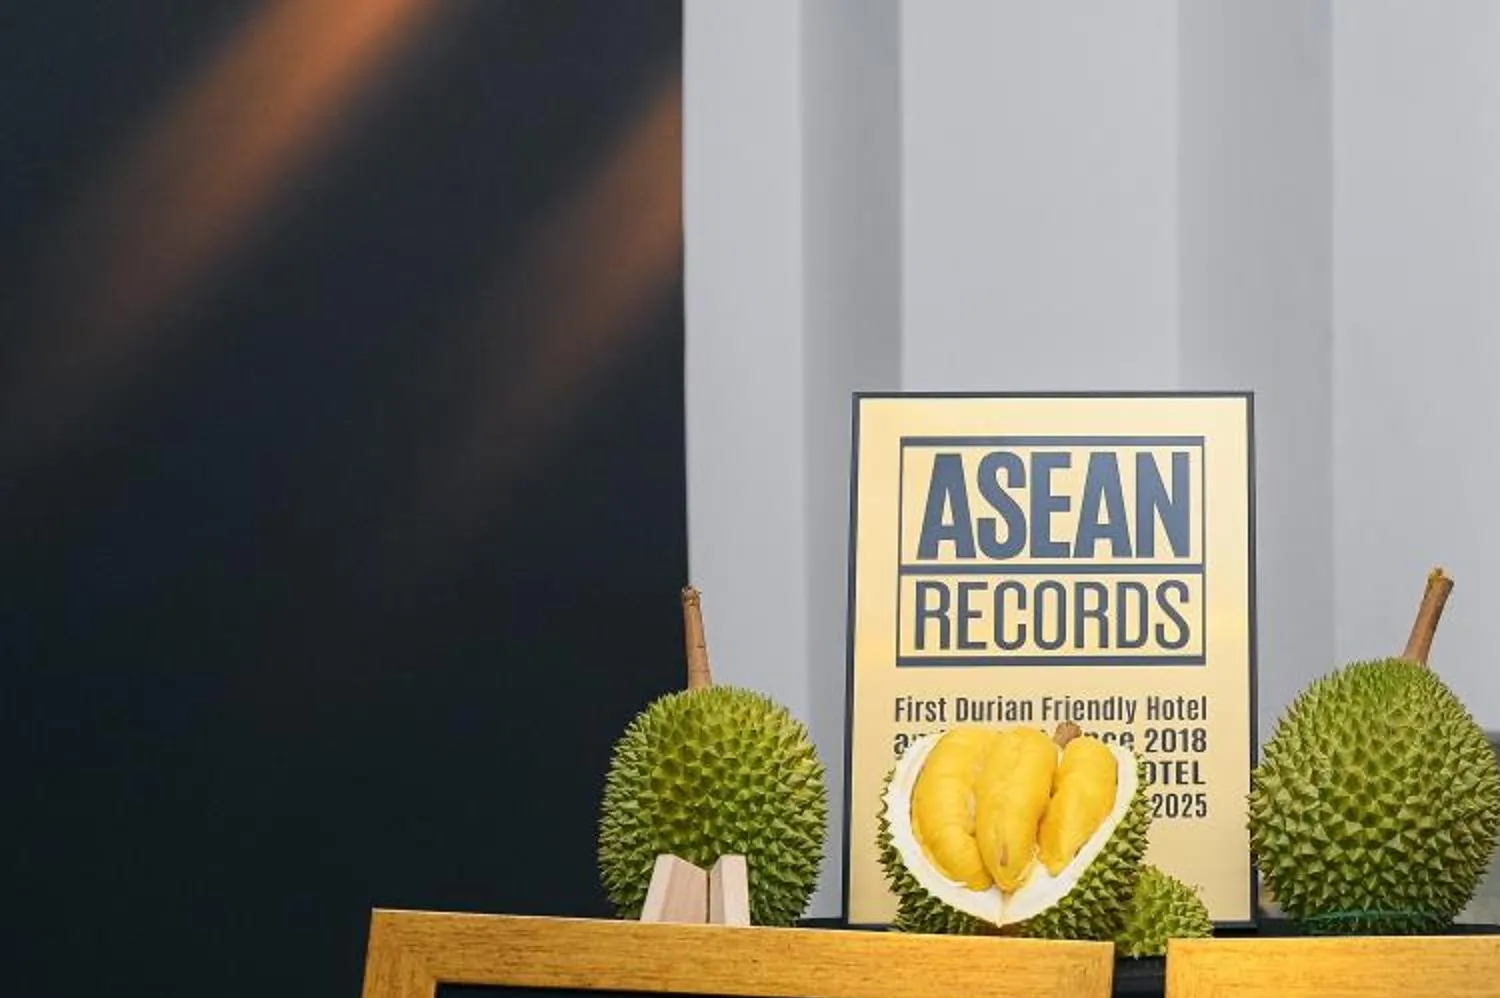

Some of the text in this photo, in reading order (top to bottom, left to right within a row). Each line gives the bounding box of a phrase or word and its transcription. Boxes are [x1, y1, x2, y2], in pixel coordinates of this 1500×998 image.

[916, 451, 1190, 560] ASEAN
[914, 580, 1190, 651] RECORDS
[895, 695, 1207, 724] First Durian Friendly Hotel
[1144, 728, 1207, 753] 2018
[1151, 793, 1207, 818] 2025
